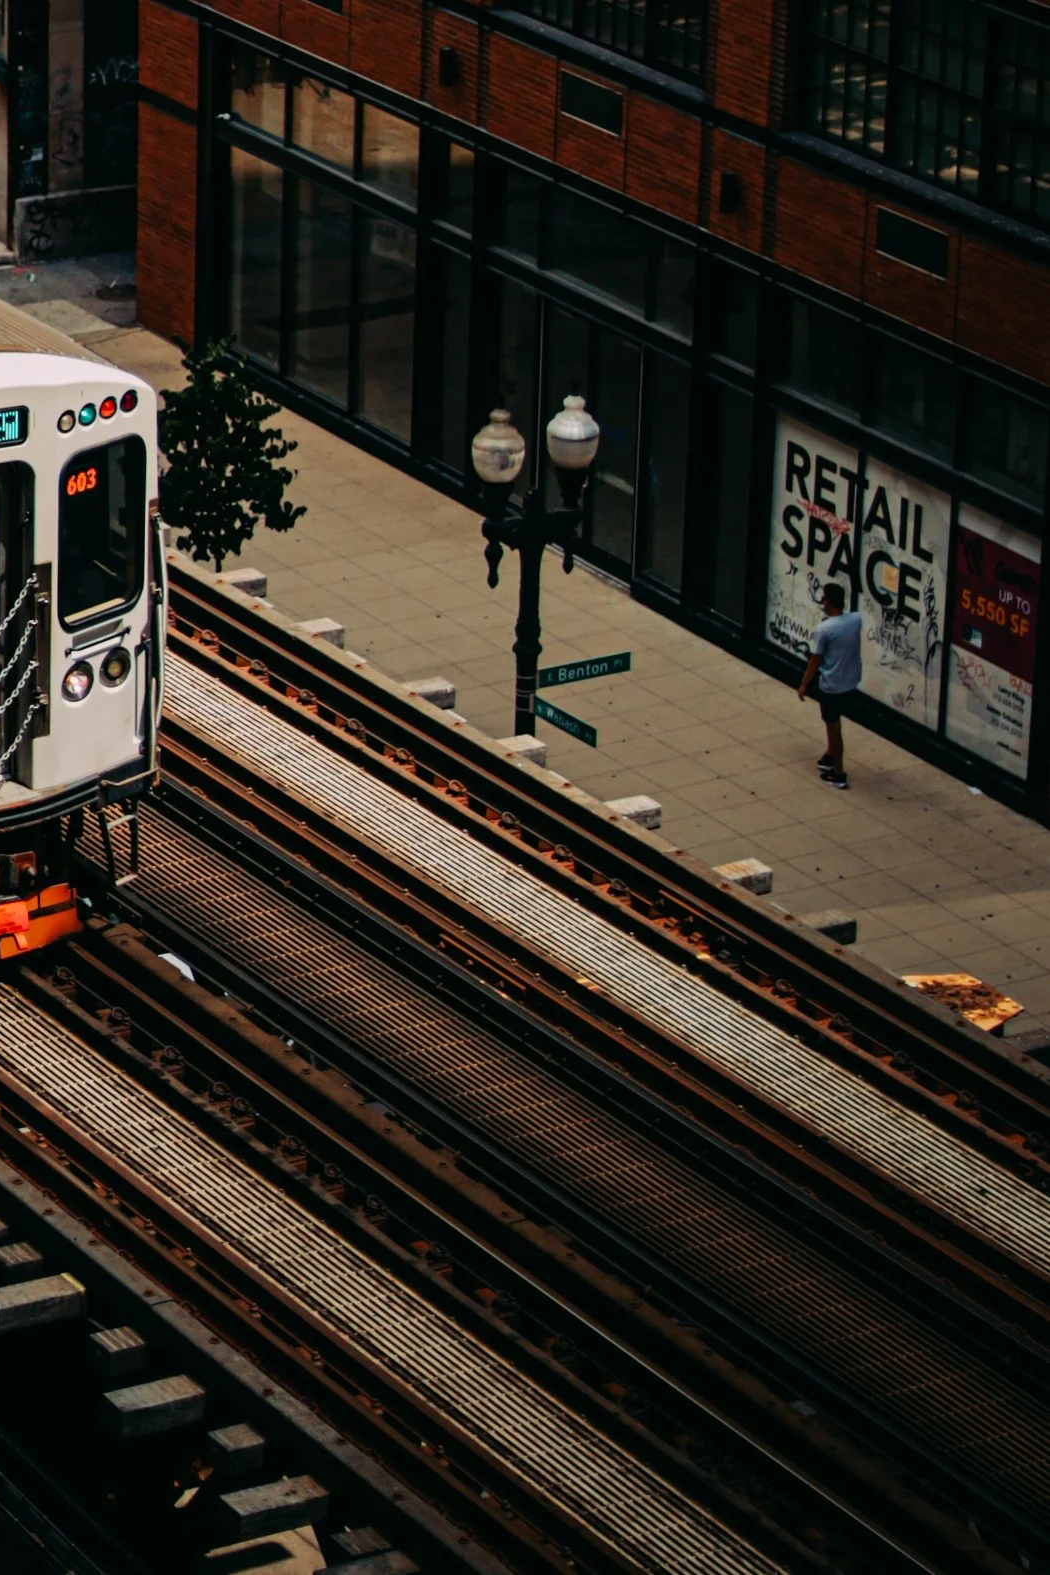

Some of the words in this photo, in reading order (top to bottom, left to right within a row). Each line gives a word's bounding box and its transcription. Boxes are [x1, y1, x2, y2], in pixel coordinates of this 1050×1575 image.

[66, 467, 97, 495] 603
[786, 440, 934, 564] RETAIL
[781, 504, 922, 623] SPACE
[961, 586, 1006, 628] 5,550
[1009, 613, 1030, 638] SF
[998, 588, 1013, 605] UP
[1014, 596, 1031, 615] TO
[775, 612, 815, 642] NEWMA
[558, 662, 609, 682] Benton
[546, 706, 581, 738] Wabash
